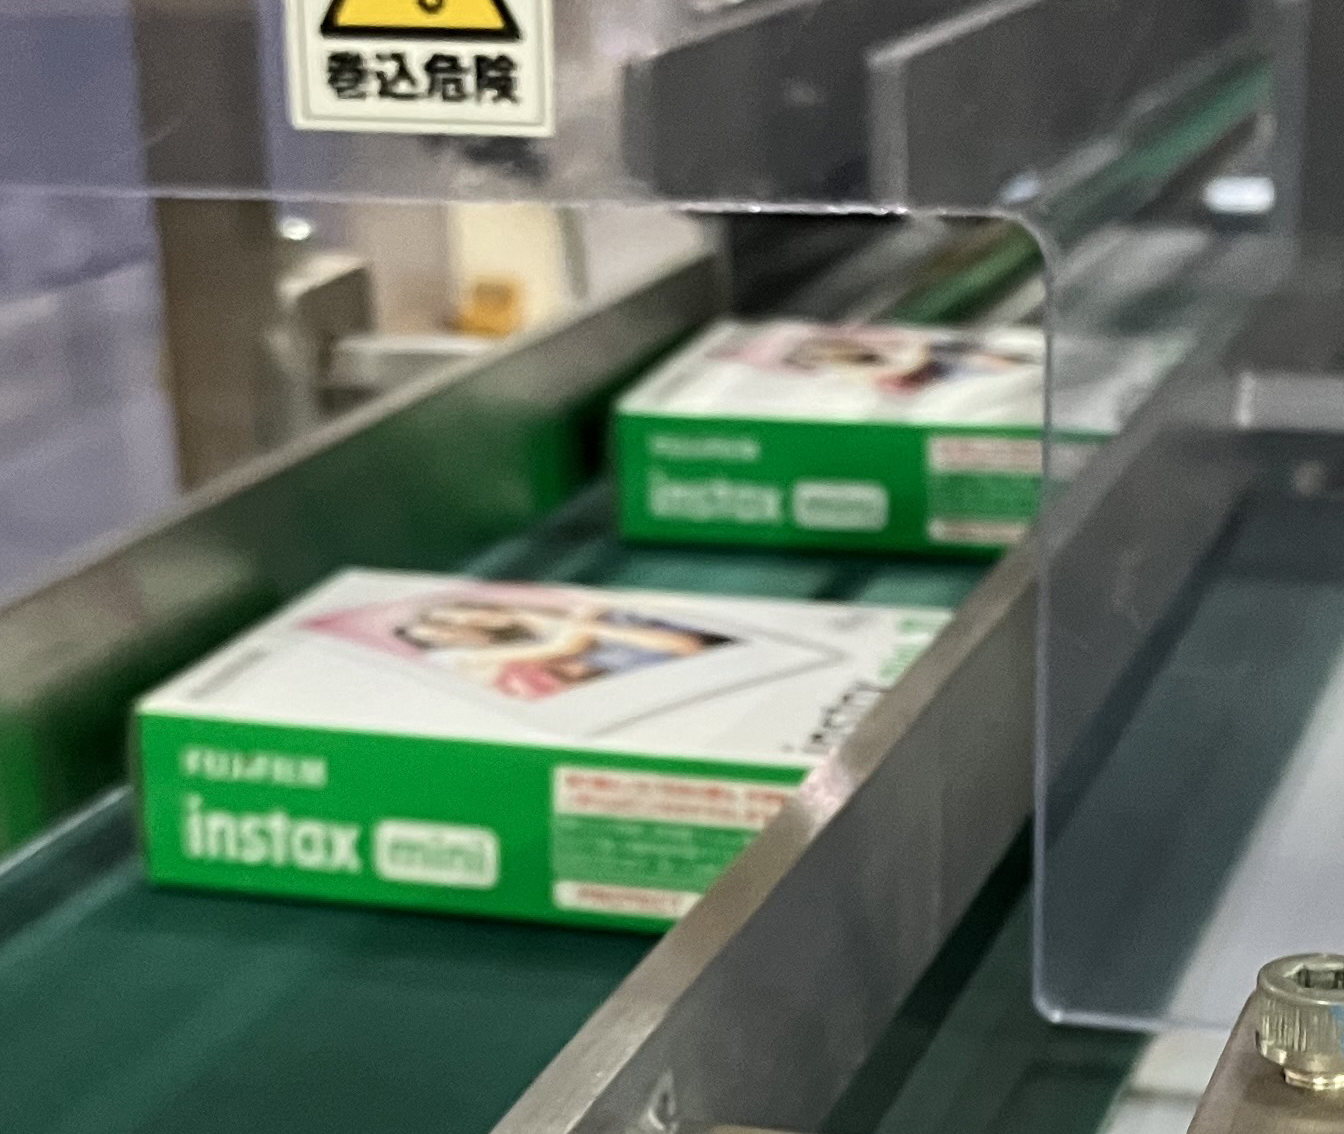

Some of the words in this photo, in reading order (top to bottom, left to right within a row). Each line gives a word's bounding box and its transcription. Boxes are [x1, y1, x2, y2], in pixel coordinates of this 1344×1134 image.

[327, 51, 520, 104] 巻込危険
[184, 793, 361, 874] instax
